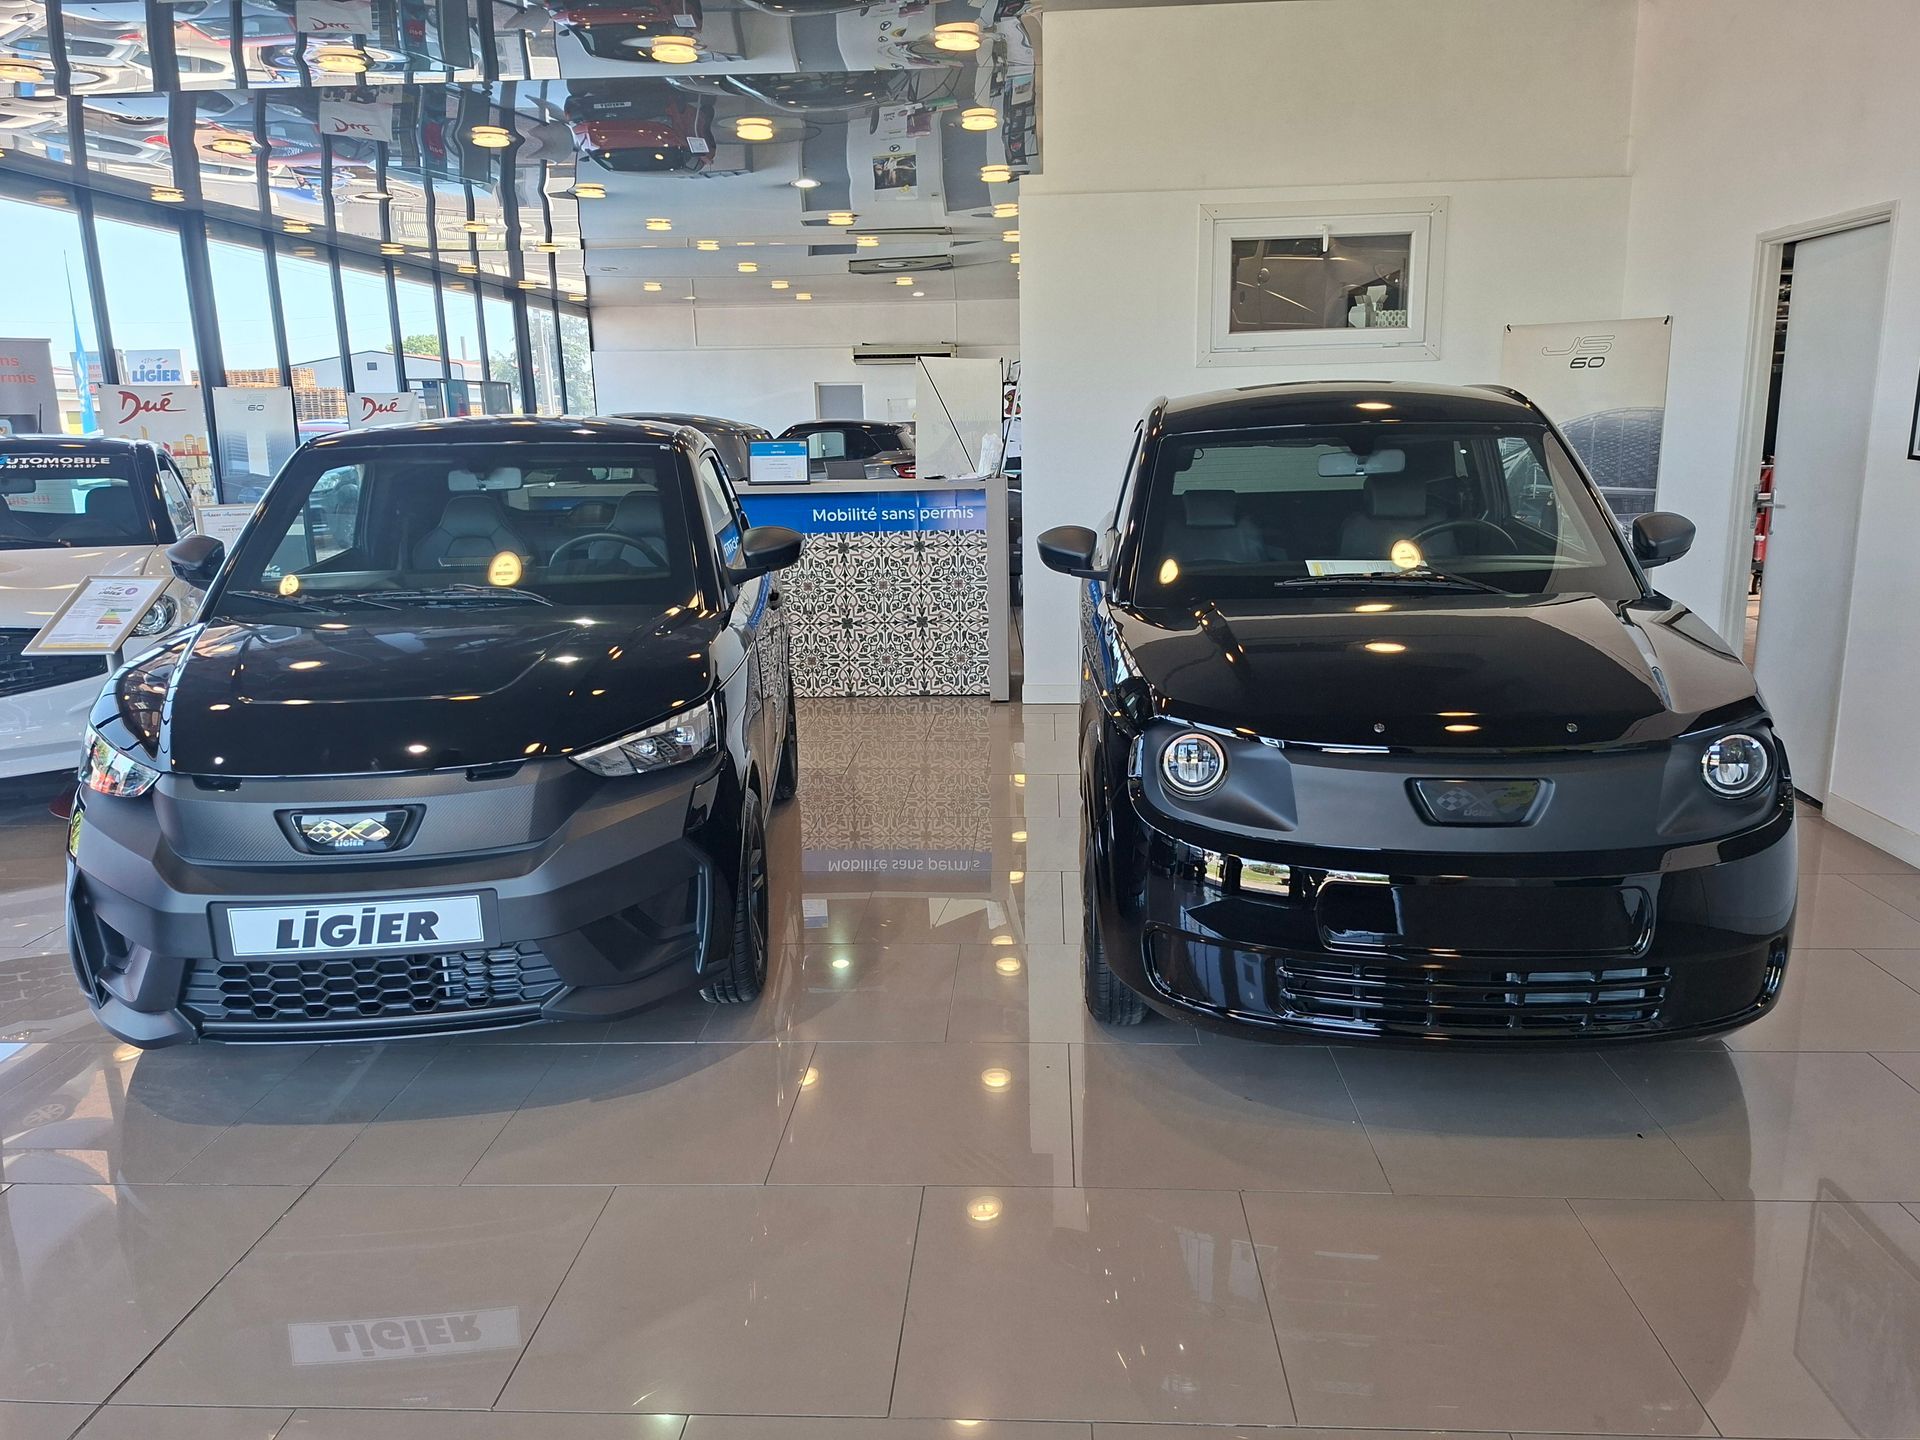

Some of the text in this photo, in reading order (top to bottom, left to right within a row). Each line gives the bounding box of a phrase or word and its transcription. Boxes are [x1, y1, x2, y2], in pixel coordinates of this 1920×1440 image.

[1569, 356, 1605, 369] 60
[118, 390, 186, 424] Dué
[361, 397, 409, 421] Dué
[812, 506, 974, 522] Mobilité sans permis
[276, 907, 439, 949] LiGiER
